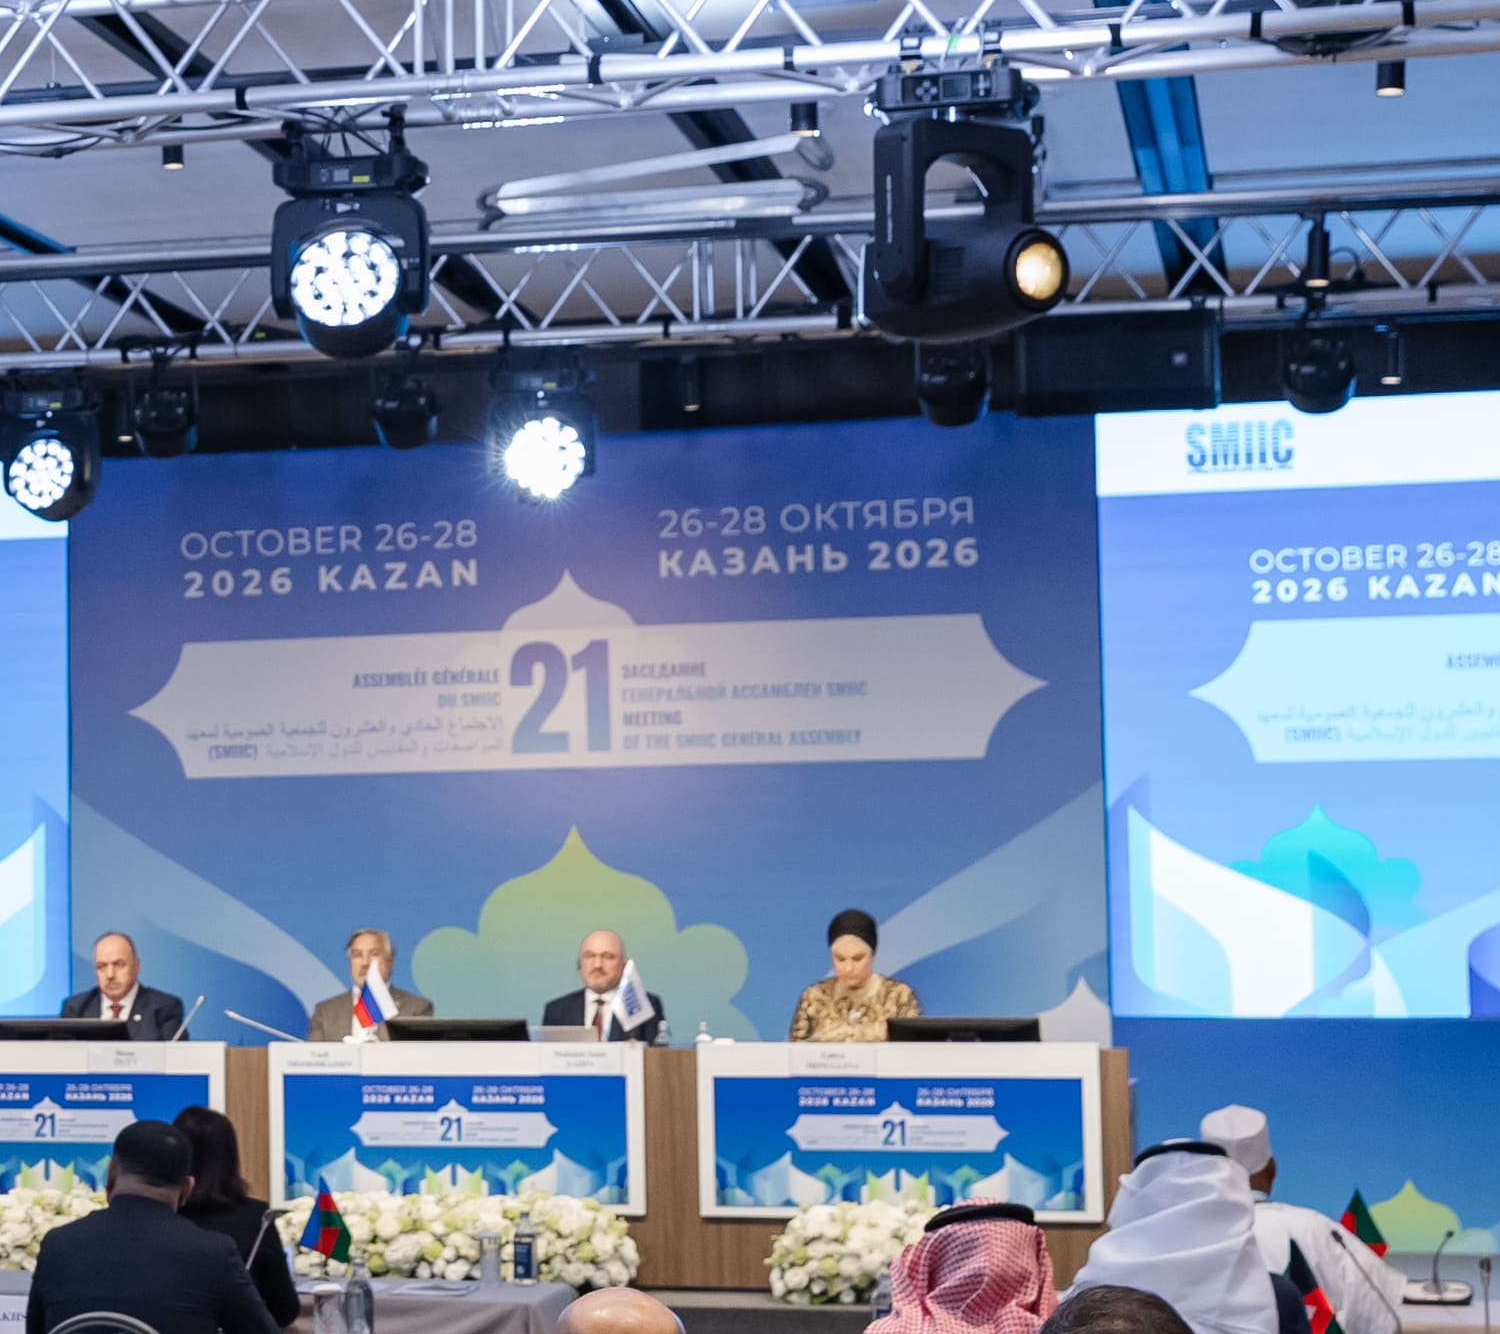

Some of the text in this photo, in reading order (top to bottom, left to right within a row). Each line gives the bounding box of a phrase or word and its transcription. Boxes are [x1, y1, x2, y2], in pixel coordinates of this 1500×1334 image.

[1185, 419, 1294, 468] SMIIC
[658, 496, 975, 539] 26-28 ОКТЯБРЯ
[180, 519, 478, 560] OCTOBER 26-28
[658, 537, 979, 578] КАЗАНЬ 2026
[1249, 543, 1408, 574] OCTOBER
[184, 558, 479, 598] 2026 KAZAN
[1251, 577, 1349, 604] 2026
[508, 639, 612, 754] 21
[34, 1112, 56, 1138] 21
[440, 1116, 462, 1142] 21
[881, 1120, 906, 1146] 21
